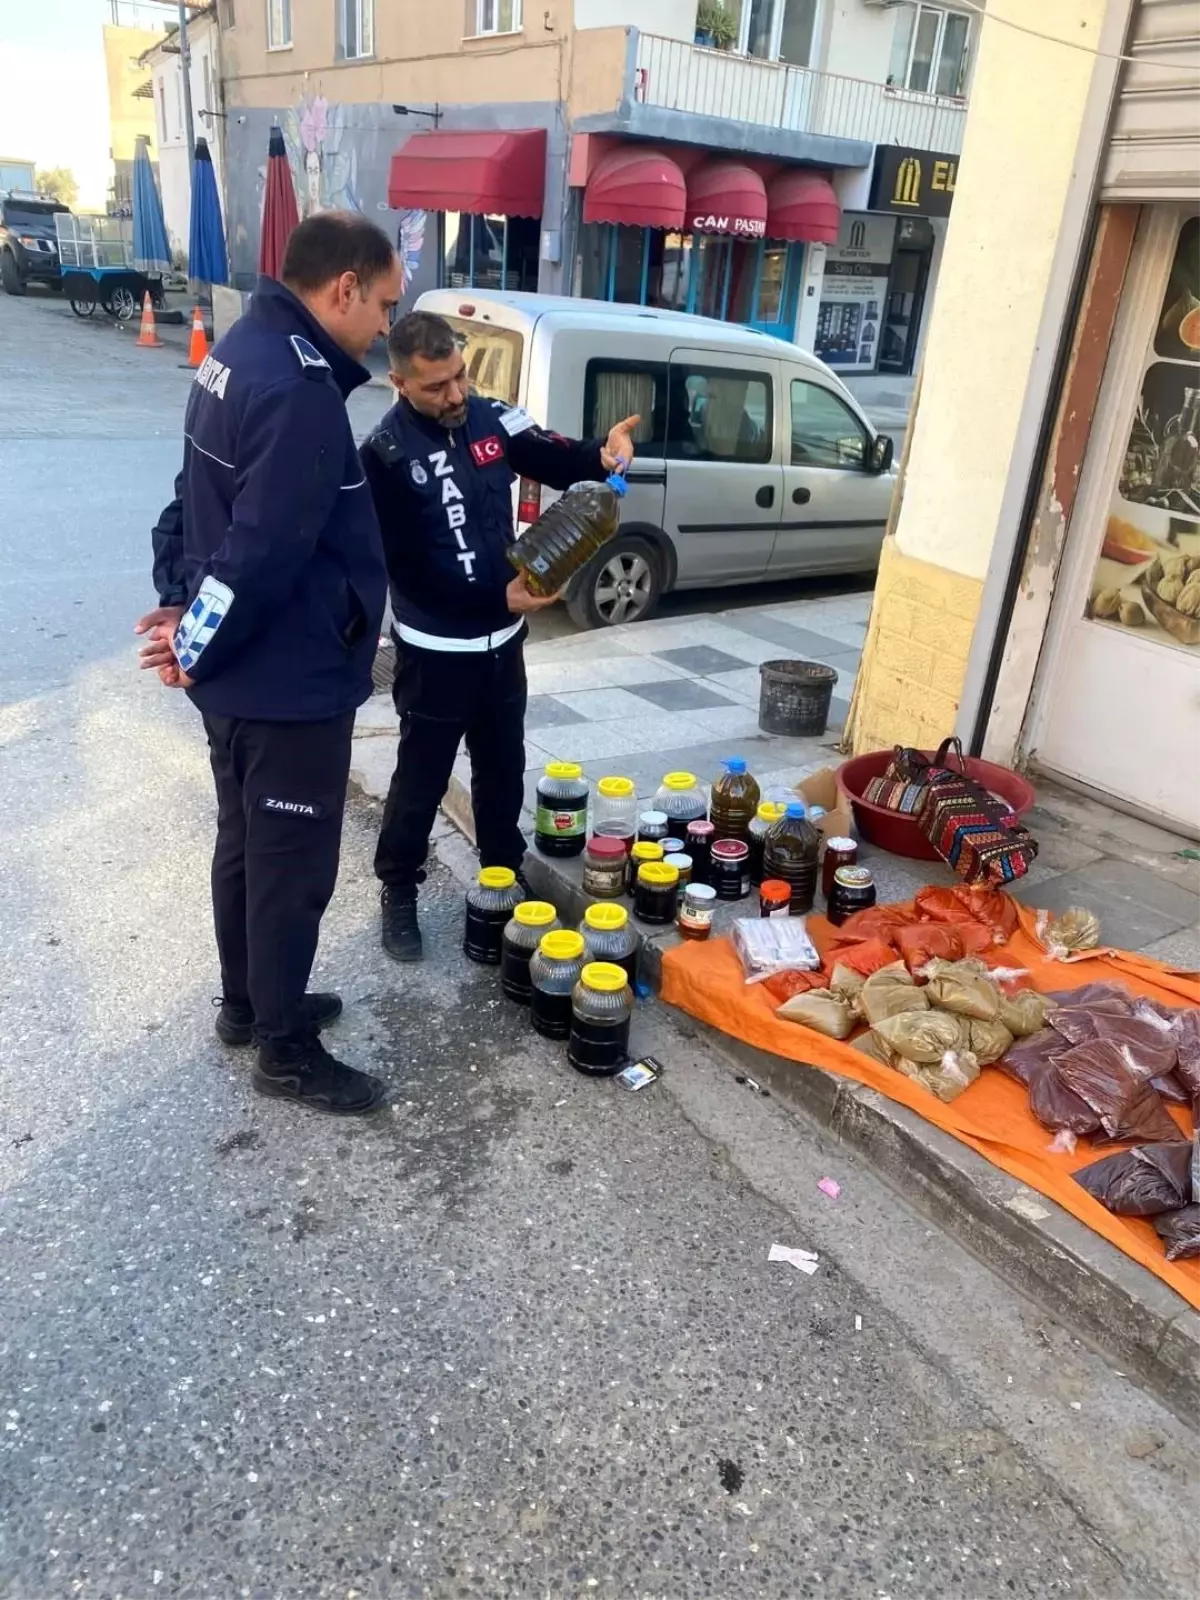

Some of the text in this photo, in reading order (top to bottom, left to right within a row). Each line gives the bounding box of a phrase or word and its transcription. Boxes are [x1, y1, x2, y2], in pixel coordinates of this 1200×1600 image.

[931, 160, 957, 192] EL
[693, 215, 729, 228] CAN
[428, 450, 476, 581] ZABIT
[266, 798, 313, 814] ZABITA
